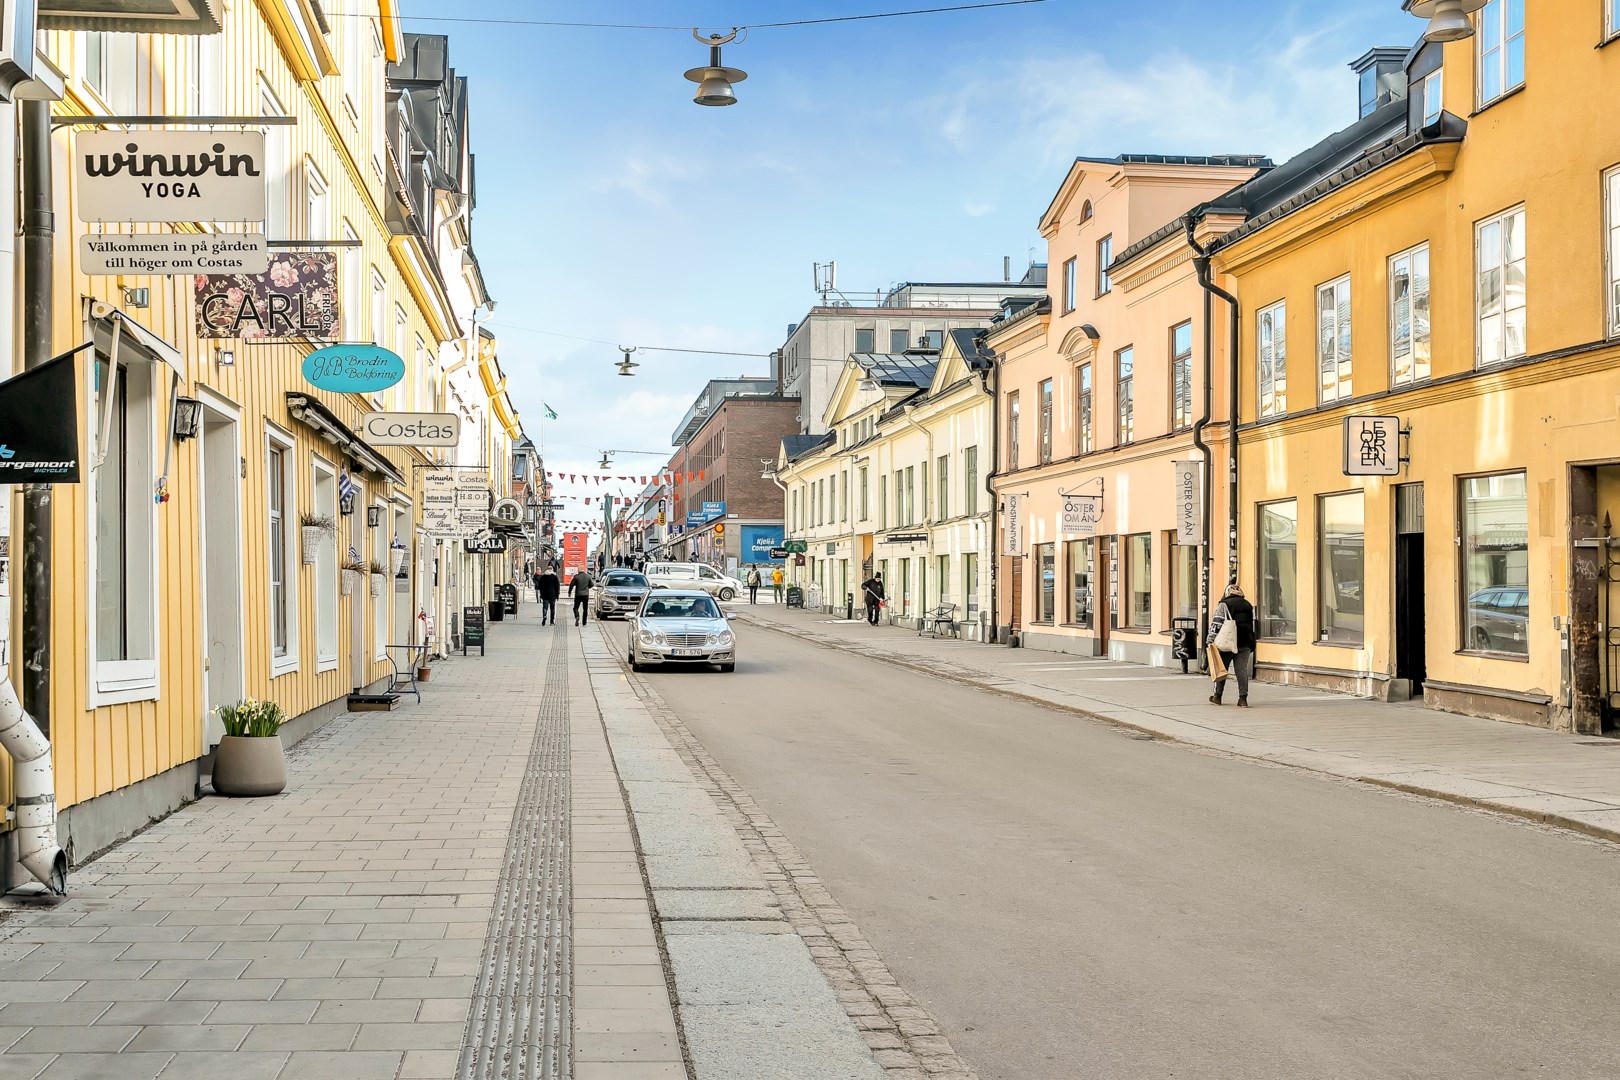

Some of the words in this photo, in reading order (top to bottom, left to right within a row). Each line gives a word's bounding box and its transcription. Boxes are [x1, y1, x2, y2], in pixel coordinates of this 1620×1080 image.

[85, 143, 260, 177] winwin
[141, 182, 200, 198] YOGA
[88, 241, 169, 253] Välkommen
[173, 241, 187, 253] in
[191, 240, 208, 255] på
[212, 240, 258, 255] gården
[105, 257, 124, 270] till
[129, 257, 167, 271] höger
[171, 260, 193, 269] om
[196, 257, 242, 269] Costas
[202, 293, 320, 330] CARL
[345, 355, 388, 366] Brodin
[345, 367, 398, 380] Bokföring
[368, 418, 453, 447] Costas
[459, 475, 488, 484] Costas
[1183, 472, 1195, 500] ÖSTER
[1064, 500, 1095, 513] ÖSTER
[1184, 502, 1193, 519] OM
[1064, 513, 1080, 523] OM
[1080, 512, 1095, 523] ÅN
[1185, 521, 1196, 536] ÅN
[467, 539, 504, 549] UPSALA
